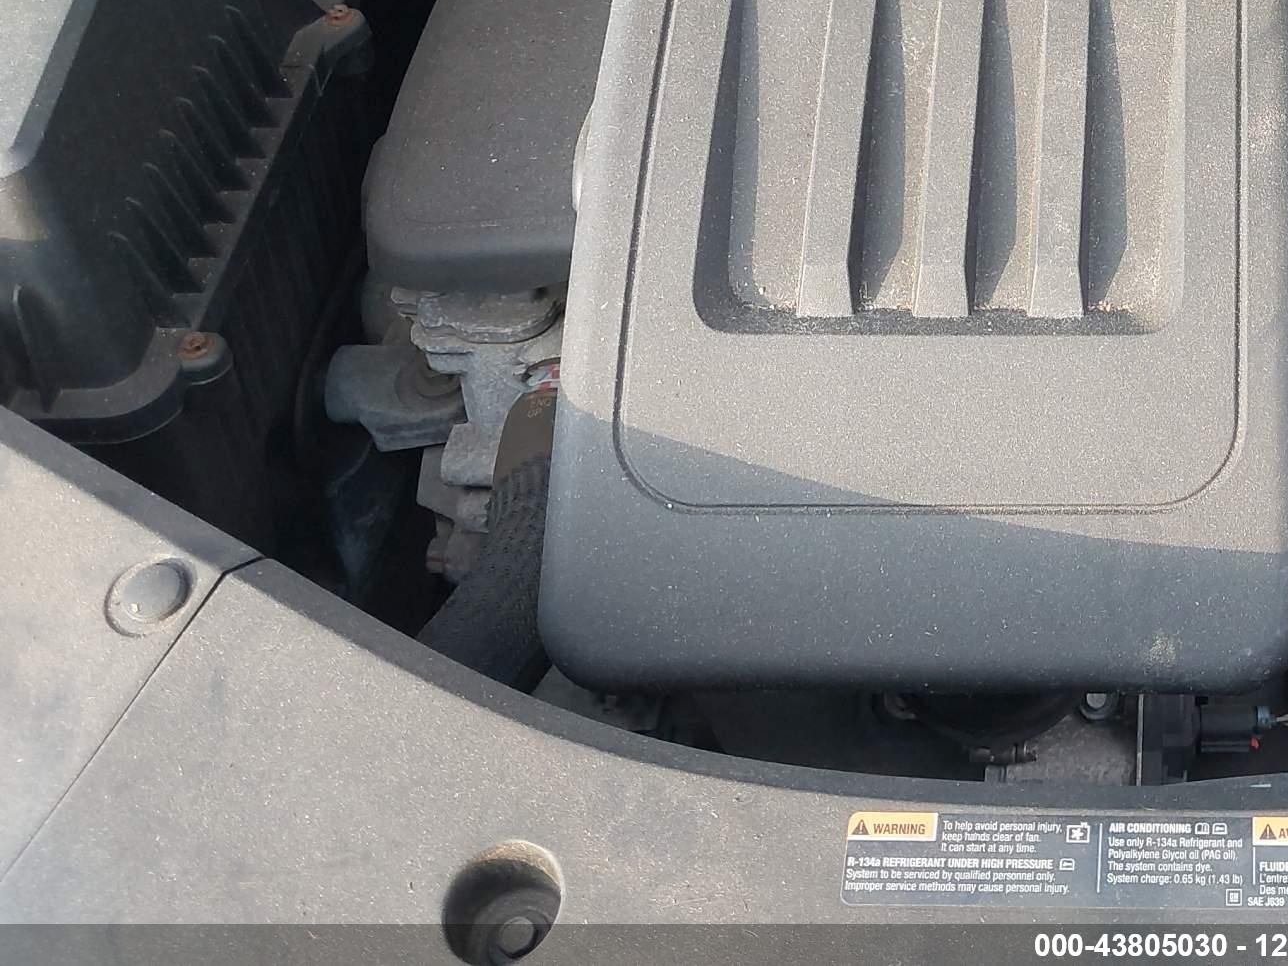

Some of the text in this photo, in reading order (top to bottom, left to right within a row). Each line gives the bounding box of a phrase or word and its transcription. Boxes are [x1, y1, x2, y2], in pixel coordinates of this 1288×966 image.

[874, 823, 925, 835] WARNING
[955, 822, 973, 832] help
[975, 822, 997, 831] avoid
[1000, 823, 1035, 833] personal
[1037, 823, 1062, 833] injury,
[1109, 823, 1191, 833] AIR CONDITIONING
[942, 832, 962, 843] keep
[965, 833, 991, 842] hands
[994, 833, 1013, 842] clear
[1026, 834, 1041, 842] fan.
[1108, 837, 1242, 849] Use only R-134a Refrigerant and
[966, 844, 986, 853] start
[999, 845, 1014, 854] any
[1016, 844, 1036, 853] time.
[1108, 849, 1159, 860] Polyalkylene
[1162, 850, 1187, 861] Glycol
[1202, 850, 1221, 860] (PAG
[1223, 851, 1238, 860] oil).
[848, 857, 1053, 869] R-134a REFRIGERANT UNDER HIGH PRESSURE
[1108, 861, 1212, 873] The system contains dye.
[847, 869, 878, 879] System
[904, 870, 940, 880] serviced
[955, 870, 991, 882] qualified
[993, 871, 1034, 882] personnel
[1036, 871, 1055, 882] only.
[1107, 874, 1138, 884] System
[1141, 874, 1171, 885] charge:
[1174, 875, 1193, 883] 0.65
[1208, 875, 1230, 884] (1.43
[845, 881, 1069, 893] Improper service methods may cause personal injury.
[1260, 885, 1275, 895] Des
[1248, 897, 1285, 906] SAE J639
